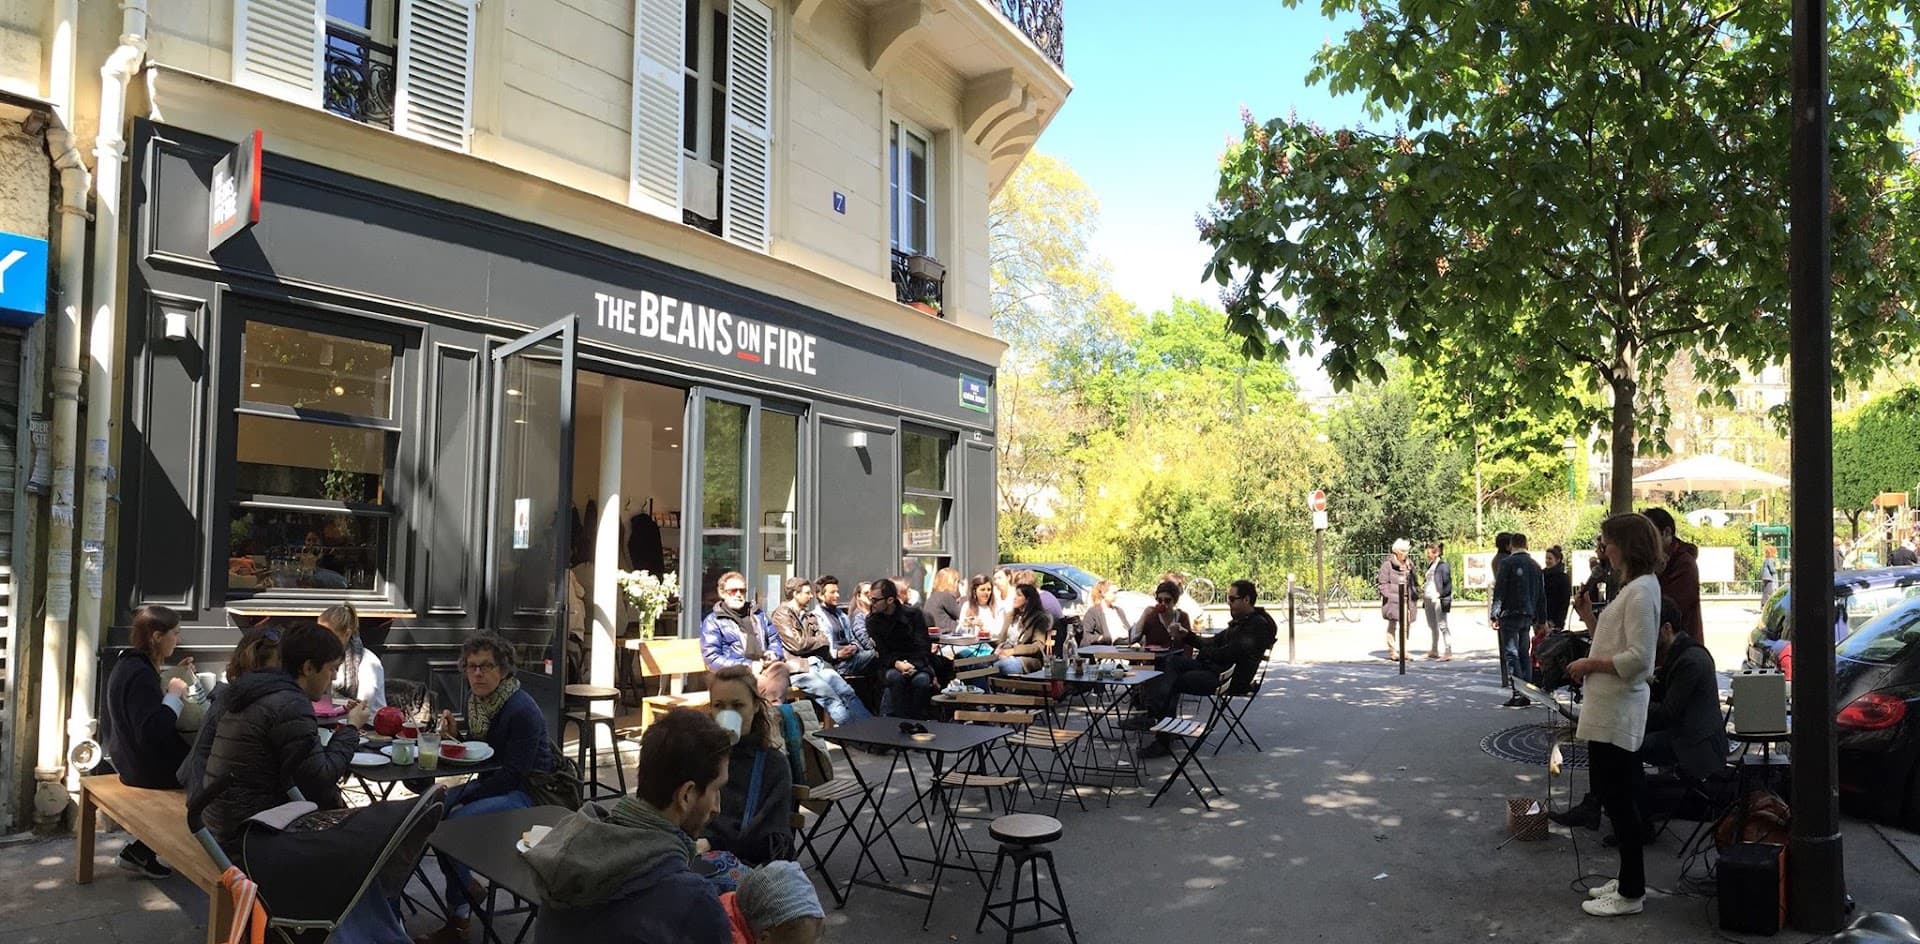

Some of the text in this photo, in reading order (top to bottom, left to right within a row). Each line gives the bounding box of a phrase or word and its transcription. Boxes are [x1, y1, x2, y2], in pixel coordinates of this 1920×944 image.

[836, 194, 843, 210] 7
[594, 290, 817, 376] THE BEANS ON FIRE
